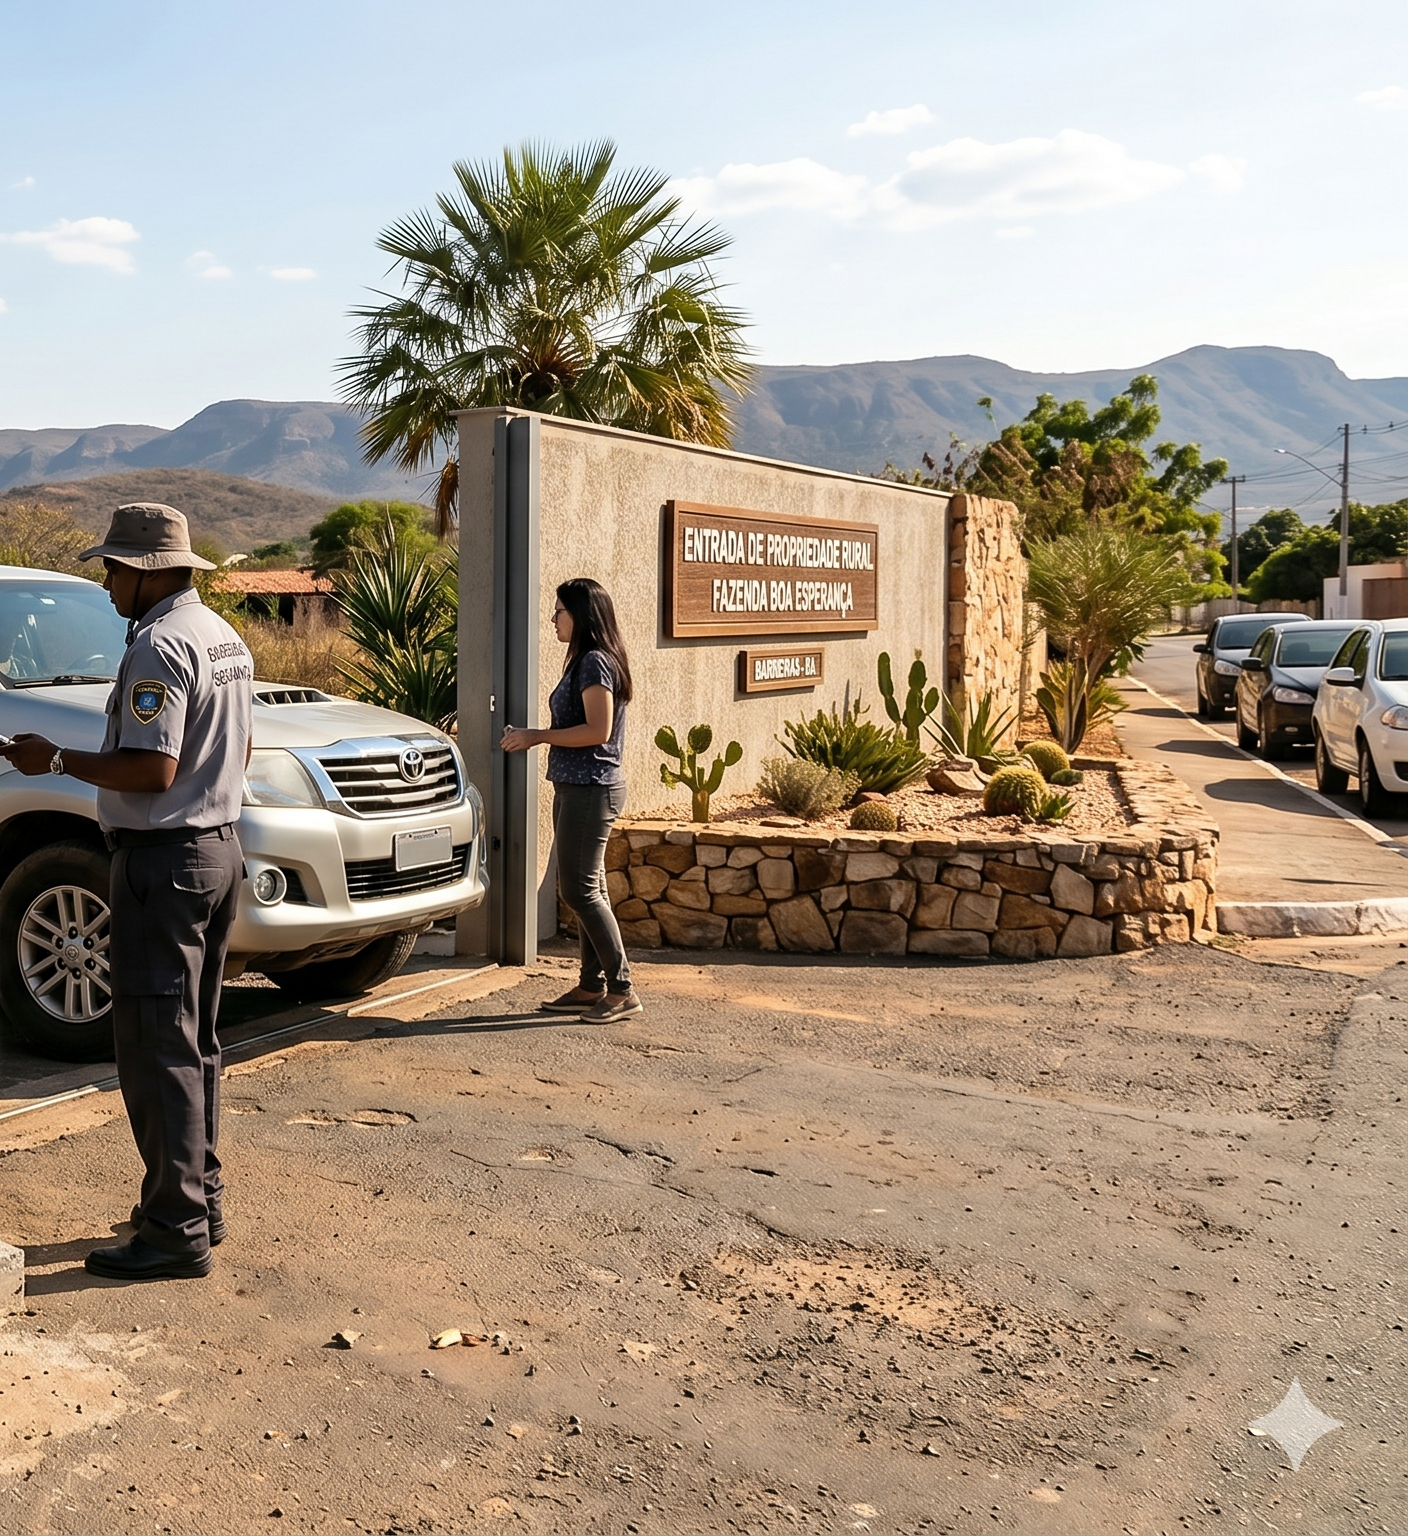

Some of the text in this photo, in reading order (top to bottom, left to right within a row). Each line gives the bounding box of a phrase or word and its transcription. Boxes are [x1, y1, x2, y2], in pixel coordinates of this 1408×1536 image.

[684, 527, 873, 570] ENTRADA DE PROPRIEDADE RURAL
[713, 579, 854, 618] FAZENDA BOA ESPERANÇA
[805, 657, 816, 676] BA
